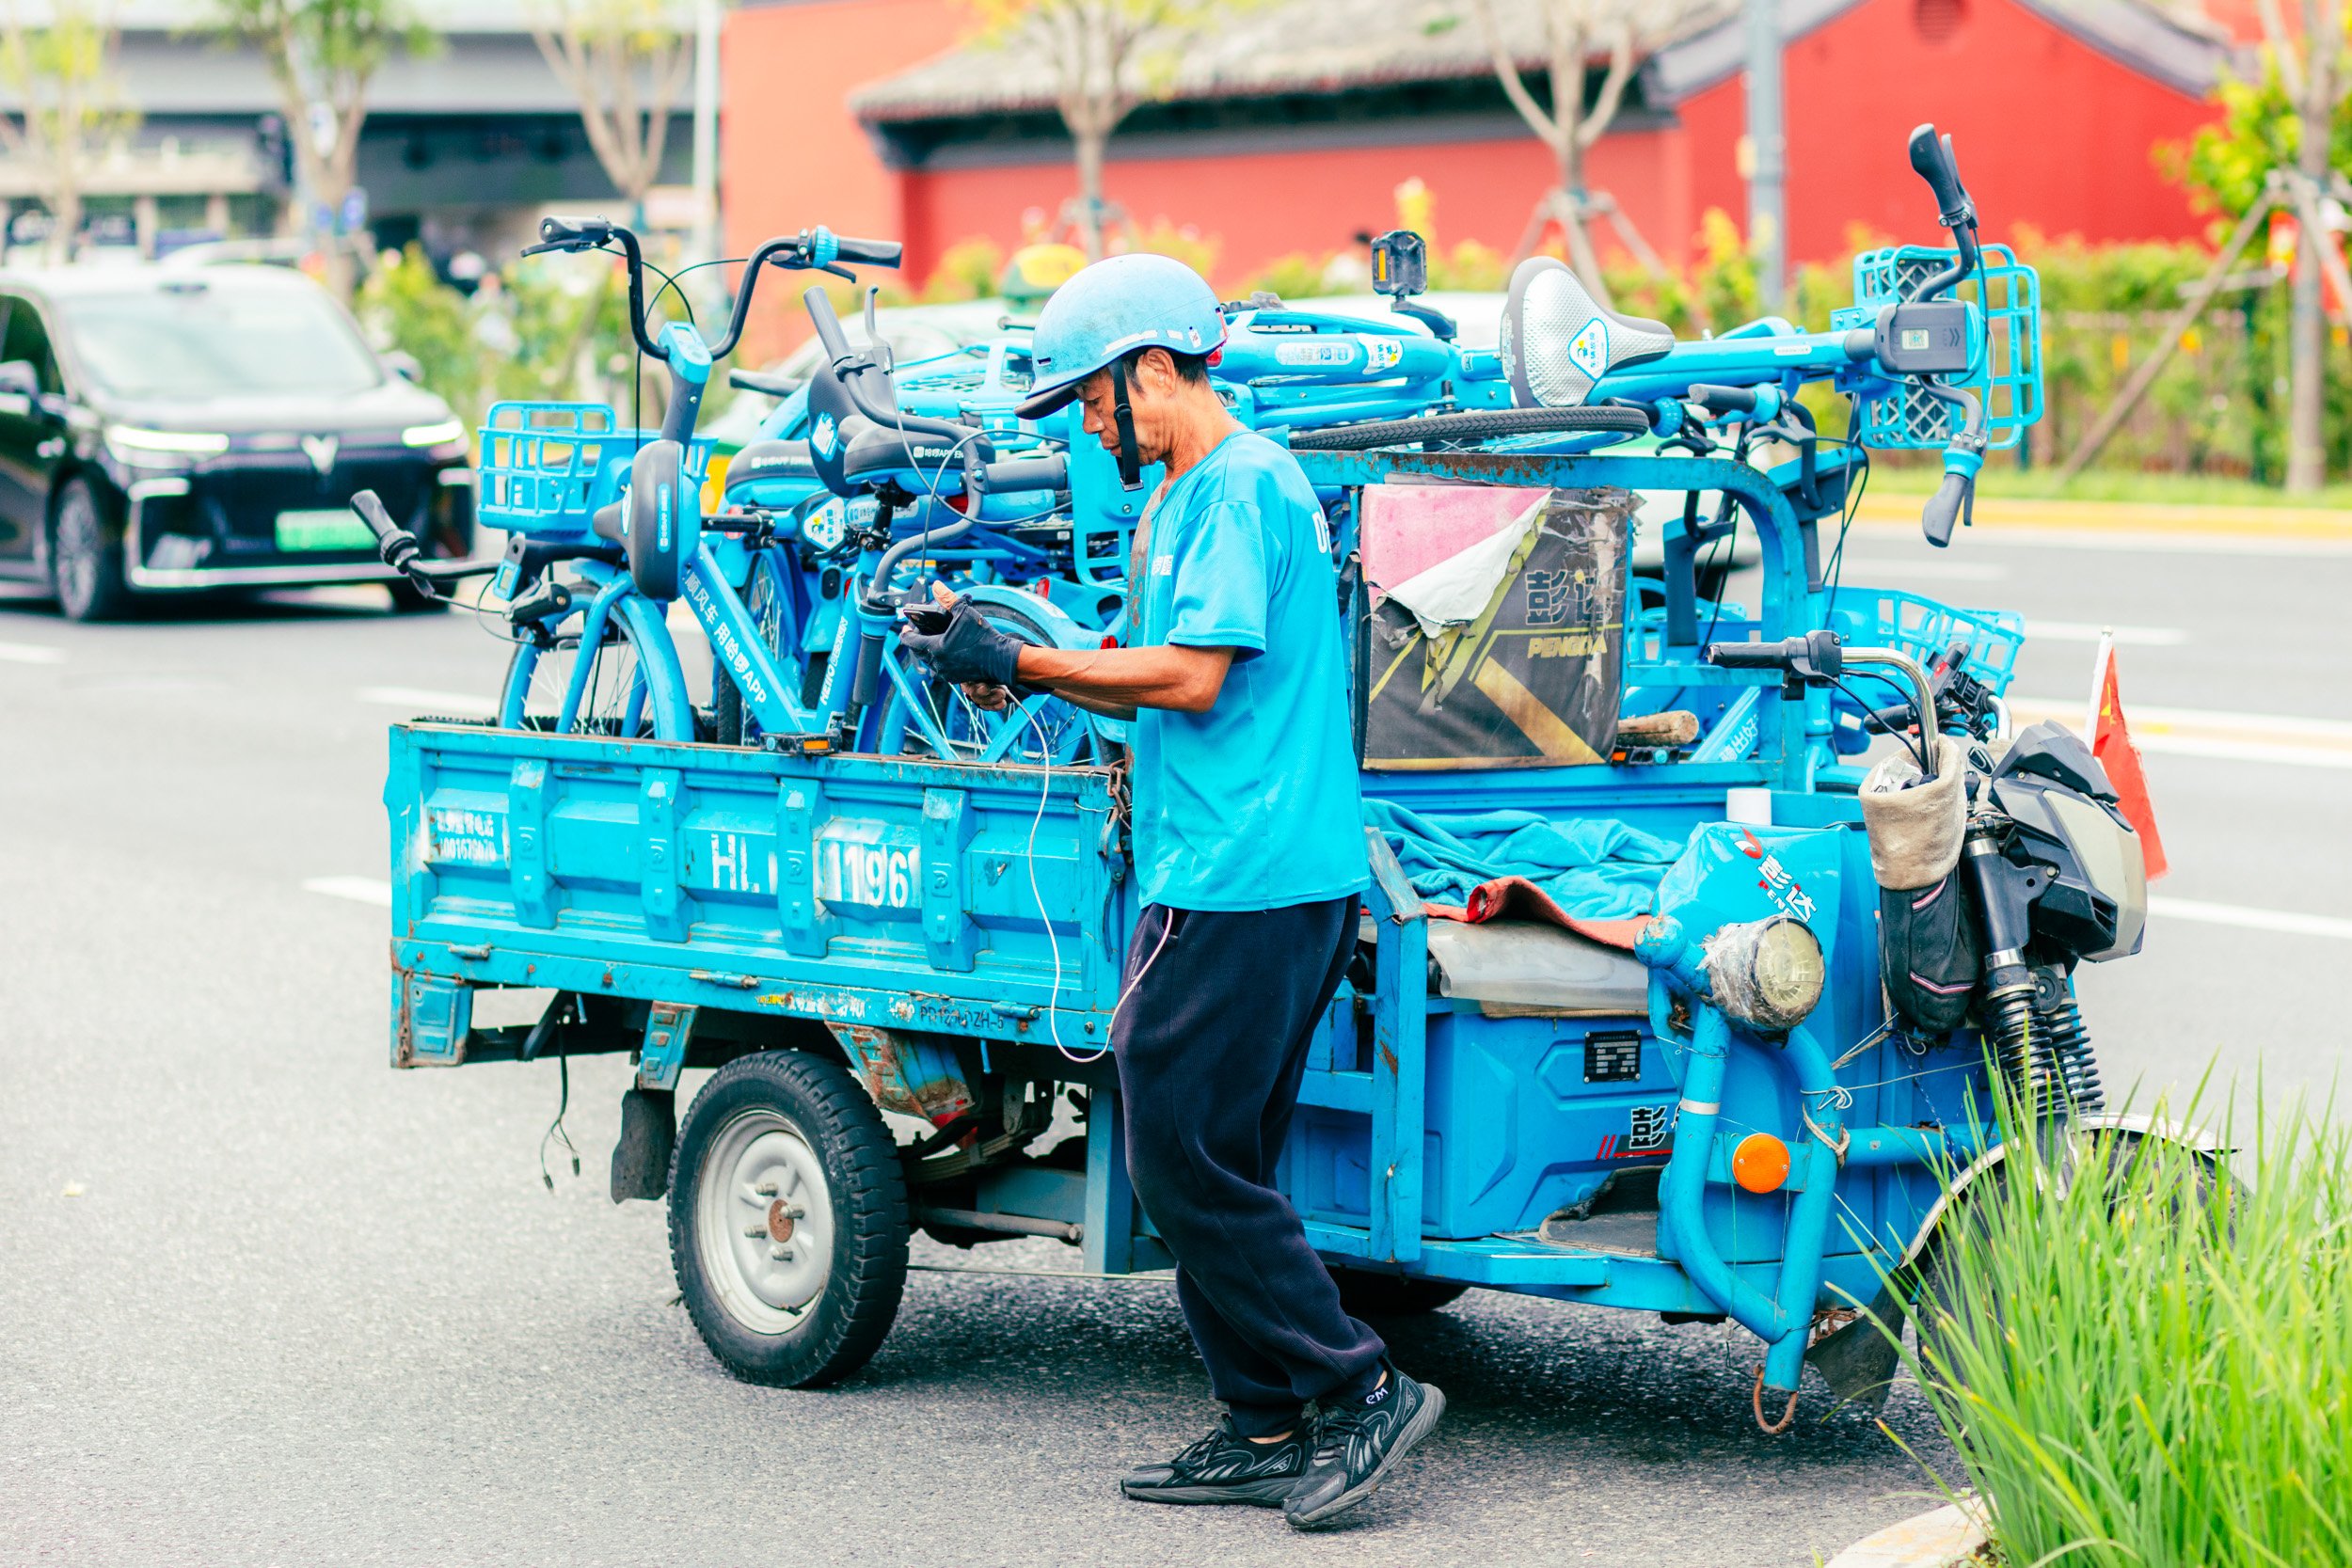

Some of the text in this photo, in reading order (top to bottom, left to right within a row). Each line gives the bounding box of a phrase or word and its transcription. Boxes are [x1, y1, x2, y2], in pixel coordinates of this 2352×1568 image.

[682, 569, 719, 626] 顺风车
[1756, 853, 1817, 923] 彭达
[1629, 1104, 1679, 1149] 彭
